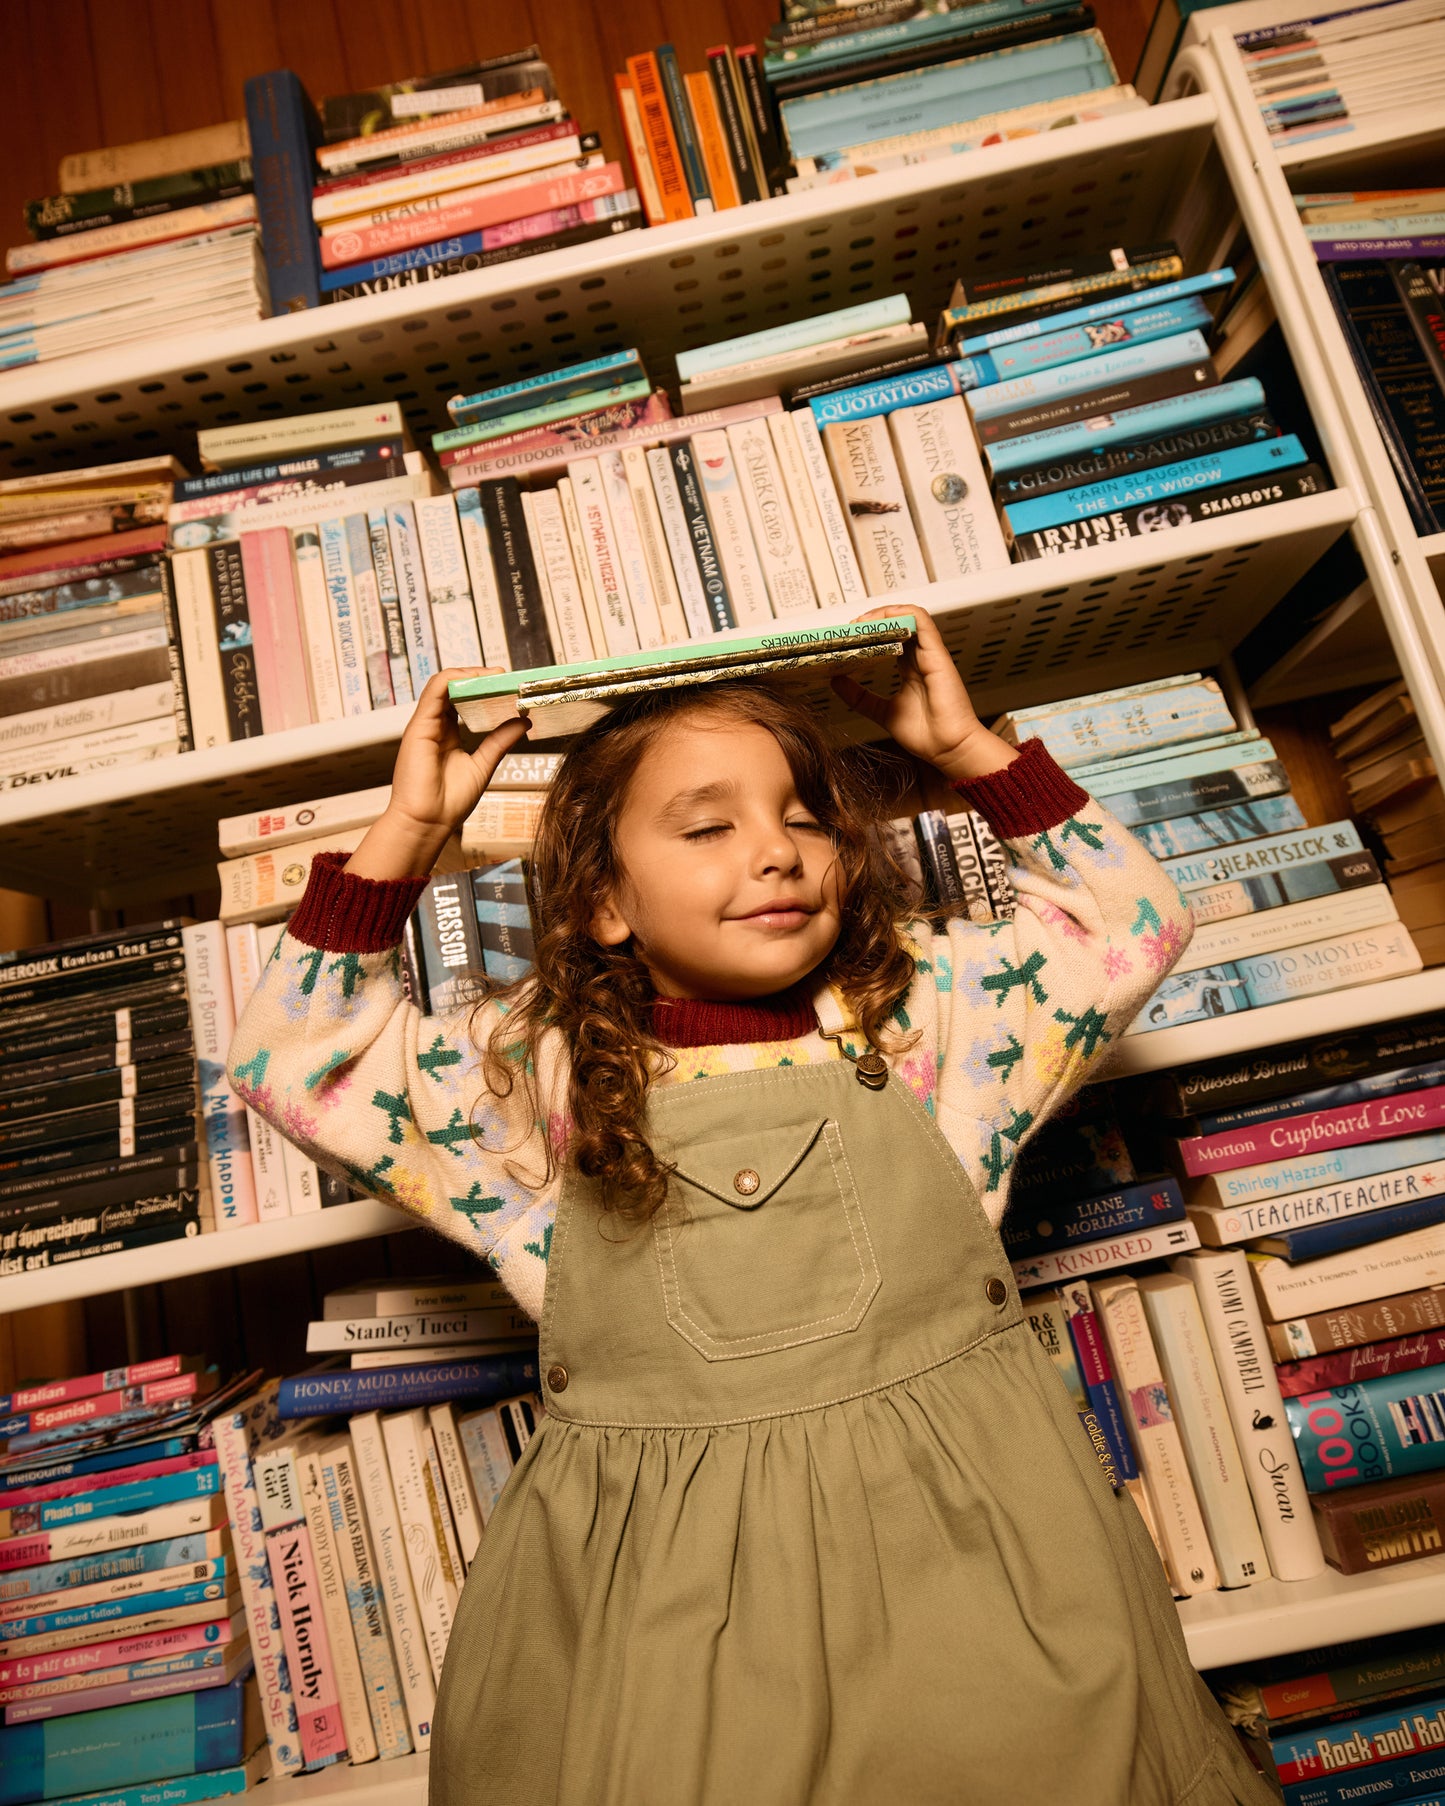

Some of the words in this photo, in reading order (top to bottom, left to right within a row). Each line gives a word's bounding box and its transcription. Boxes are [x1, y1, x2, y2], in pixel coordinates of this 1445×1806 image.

[371, 196, 440, 225] BEACH
[372, 237, 463, 276] DETAILS
[820, 373, 950, 421] QUOTATIONS
[466, 460, 492, 477] THE
[495, 446, 565, 469] OUTDOOR
[573, 433, 618, 452] ROOM
[626, 421, 674, 442] JAMIE
[677, 410, 721, 430] DURIE
[843, 427, 871, 488] MARTIN
[914, 410, 943, 473] MARTIN
[1019, 459, 1107, 490] GEORGE
[1134, 423, 1250, 461] SAUNDERS
[183, 480, 202, 492] THE
[204, 474, 243, 488] SECRET
[242, 468, 263, 482] LIFE
[264, 465, 279, 478] OF
[279, 458, 320, 476] WHALES
[653, 453, 668, 482] NICK
[1067, 482, 1119, 503] KARIN
[1125, 456, 1222, 489] SLAUGHTER
[660, 483, 676, 513] CAVE
[1076, 499, 1111, 515] THE
[1113, 488, 1154, 506] LAST
[1159, 468, 1224, 492] WIDOW
[1032, 513, 1128, 550] IRVINE
[1200, 485, 1283, 516] SKAGBOYS
[323, 540, 343, 574] LITTLE
[371, 528, 395, 595] DISGRACE
[587, 510, 618, 593] SYMPATHIZER
[691, 514, 718, 579] VIETNAM
[872, 525, 898, 589] THRONES
[944, 507, 971, 575] DRAGONS
[214, 549, 234, 617] DOWNER
[228, 553, 245, 607] LESLEY
[327, 573, 350, 620] PARIS
[402, 562, 417, 604] LAURA
[410, 607, 425, 649] FRIDAY
[336, 620, 357, 669] BOOKSHOP
[761, 632, 820, 648] NUMBERS
[823, 627, 851, 641] AND
[855, 621, 901, 636] WORDS
[230, 652, 256, 719] Geisha
[257, 815, 273, 836] KING
[270, 813, 286, 832] RAT
[937, 843, 956, 896] CHARLAINE
[950, 823, 987, 902] BLOCK
[1221, 837, 1331, 874] HEARTSICK
[1198, 890, 1234, 907] KENT
[433, 883, 468, 967] LARSSON
[0, 957, 59, 983] HEROUX
[116, 942, 147, 957] Tong
[1247, 957, 1298, 984] JOJO
[1301, 938, 1380, 969] MOYES
[1185, 1066, 1250, 1095] Russell
[1253, 1055, 1309, 1080] Brand
[210, 1094, 230, 1142] MARK
[1197, 1140, 1256, 1163] Morton
[1269, 1104, 1372, 1153] Cupboard
[1378, 1102, 1426, 1126] Love
[215, 1148, 237, 1219] HADDON
[1227, 1174, 1280, 1196] Shirley
[1282, 1159, 1344, 1184] Hazzard
[1065, 1206, 1145, 1238] MORIARTY
[1076, 1196, 1126, 1218] LIANE
[1242, 1196, 1331, 1232] TEACHER,
[1329, 1175, 1420, 1215] TEACHER
[3, 1233, 18, 1249] of
[18, 1217, 99, 1247] appreciation
[1053, 1237, 1153, 1275] KINDRED
[1213, 1268, 1245, 1315] NAOMI
[344, 1323, 412, 1343] Stanley
[416, 1315, 469, 1336] Tucci
[1176, 1309, 1190, 1328] The
[1325, 1316, 1343, 1348] BEST
[1338, 1314, 1354, 1345] FOOD
[1380, 1305, 1398, 1334] 2009
[1182, 1329, 1197, 1354] Bride
[1228, 1320, 1266, 1395] CAMPBELL
[1349, 1350, 1392, 1382] falling
[1394, 1334, 1431, 1365] slowly
[17, 1385, 66, 1407] Italian
[294, 1380, 351, 1399] HONEY,
[357, 1374, 398, 1392] MUD,
[401, 1365, 480, 1387] MAGGOTS
[1188, 1355, 1207, 1396] Stripped
[34, 1400, 96, 1427] Spanish
[1200, 1397, 1213, 1419] Bare
[221, 1421, 242, 1478] MARK
[361, 1437, 376, 1465] Paul
[1081, 1412, 1107, 1453] Goldie
[1295, 1390, 1360, 1488] 1001
[1335, 1383, 1384, 1481] BOOKS
[6, 1463, 74, 1486] Melbourne
[336, 1462, 351, 1487] MISS
[1096, 1450, 1112, 1464] &
[1101, 1462, 1119, 1488] Ace
[1208, 1425, 1229, 1484] ANONYMOUS
[263, 1468, 280, 1500] Girl
[276, 1462, 294, 1510] Funny
[321, 1466, 338, 1498] PETER
[368, 1468, 385, 1517] Wilson
[427, 1446, 437, 1462] THE
[432, 1463, 445, 1501] BAMBOO
[439, 1502, 452, 1530] FLUTE
[1154, 1436, 1177, 1491] JOSTEIN
[1170, 1490, 1194, 1553] GAARDER
[1259, 1447, 1295, 1525] Swan
[230, 1482, 252, 1560] HADDON
[310, 1506, 331, 1553] RODDY
[341, 1487, 361, 1535] SMILLA'S
[351, 1535, 370, 1582] FEELING
[380, 1527, 398, 1573] Mouse
[1364, 1525, 1443, 1565] SMITH
[68, 1569, 82, 1586] MY
[83, 1563, 100, 1582] LIFE
[101, 1561, 110, 1578] IS
[118, 1553, 144, 1575] TOILET
[279, 1539, 308, 1601] Nick
[319, 1555, 339, 1600] DOYLE
[388, 1575, 402, 1601] and
[360, 1580, 375, 1602] FOR
[55, 1611, 89, 1626] Richard
[90, 1605, 123, 1620] Tulloch
[252, 1606, 272, 1647] RED
[364, 1603, 382, 1638] SNOW
[394, 1602, 409, 1623] the
[132, 1663, 168, 1679] VIVIENNE
[169, 1659, 195, 1672] NEALE
[290, 1604, 323, 1700] Hornby
[399, 1625, 420, 1690] Cossacks
[1357, 1674, 1366, 1686] A
[1367, 1663, 1402, 1683] Practical
[1405, 1659, 1430, 1673] Study
[1432, 1656, 1441, 1666] of
[261, 1654, 285, 1727] HOUSE
[1282, 1689, 1311, 1704] Govier
[1315, 1730, 1373, 1771] Rock
[1374, 1719, 1415, 1757] and
[140, 1790, 161, 1803] Terry
[162, 1787, 187, 1799] Deary
[1337, 1779, 1394, 1801] TRADITIONS
